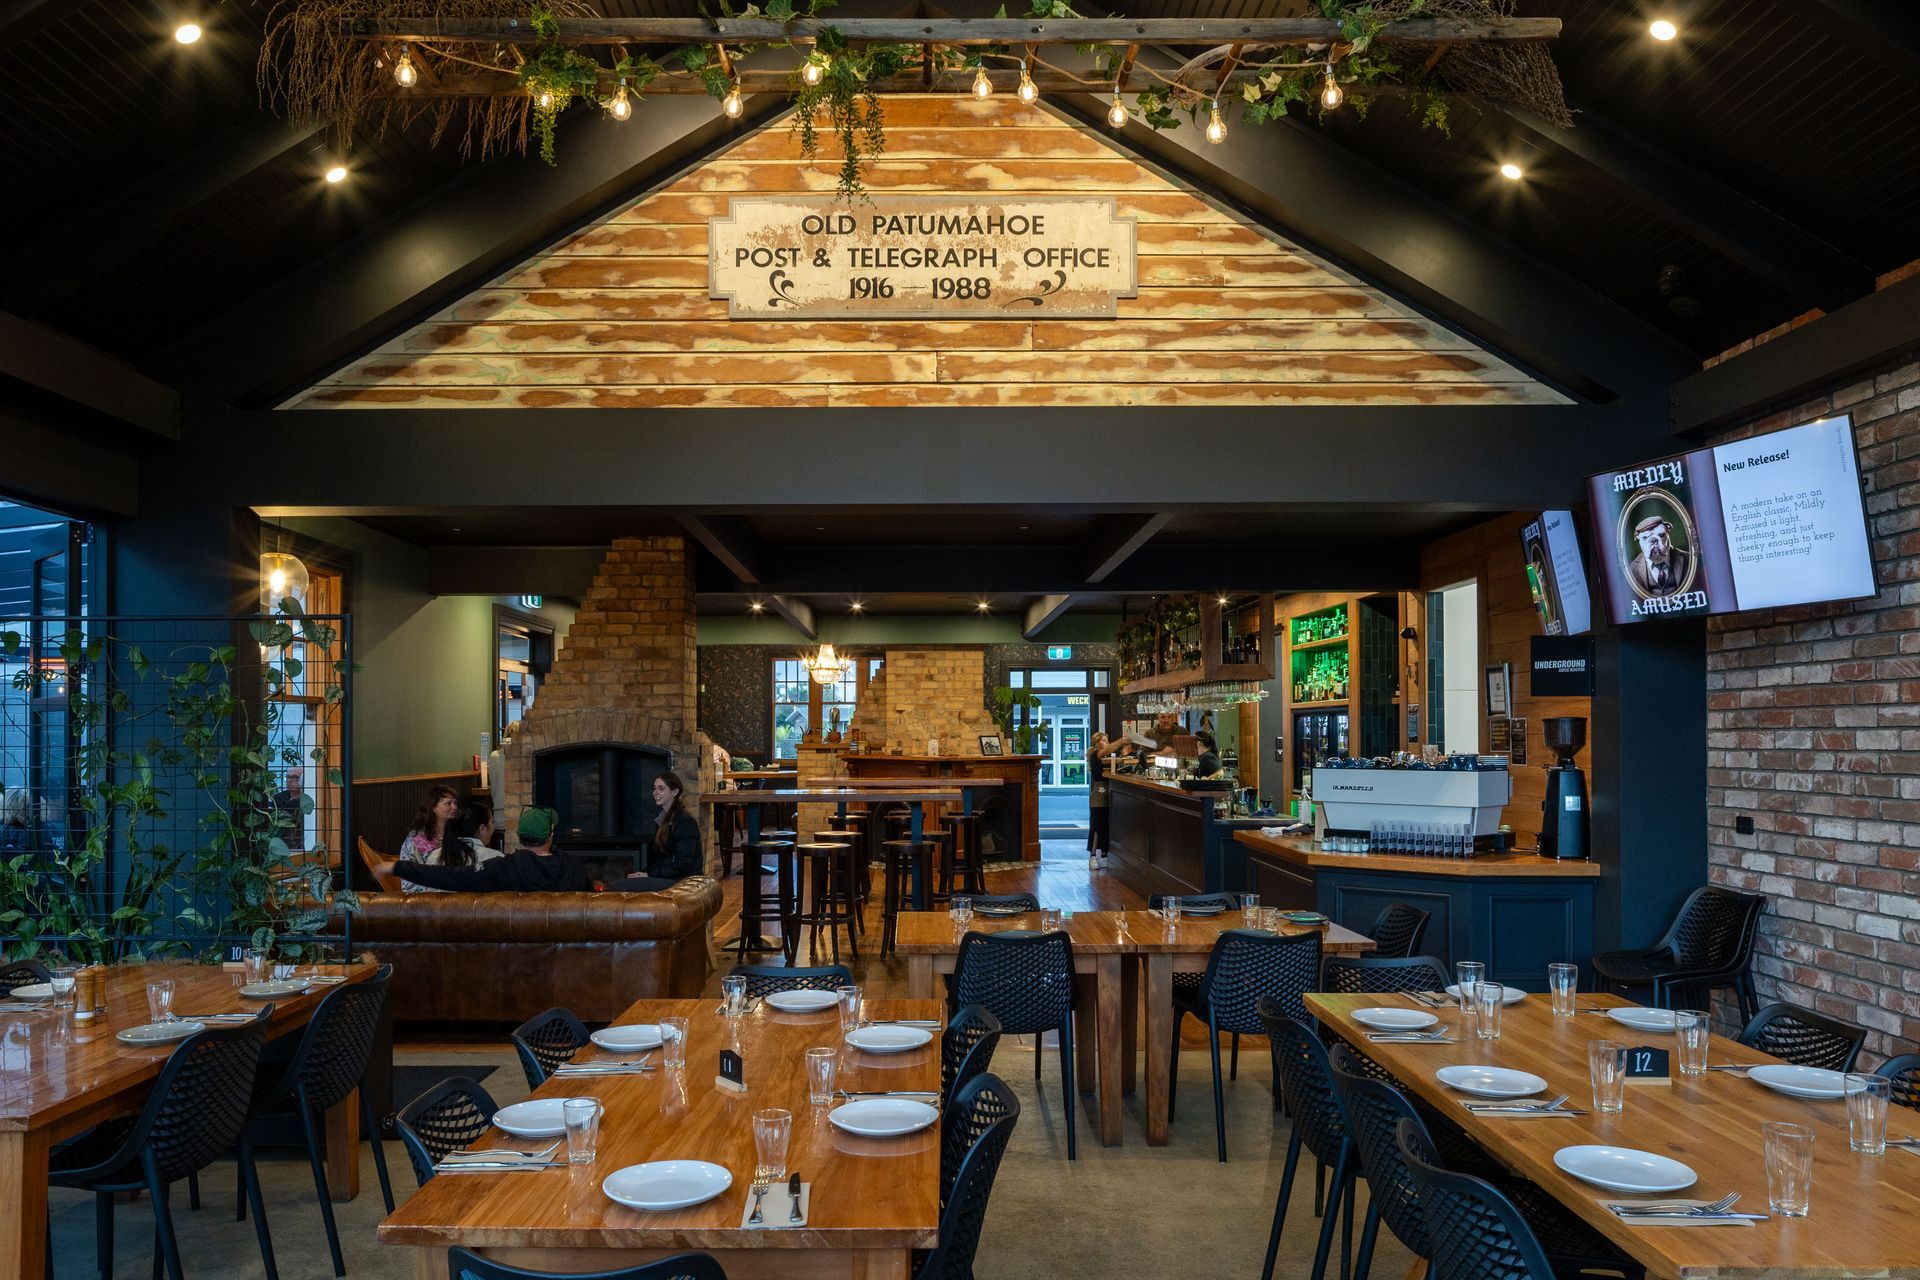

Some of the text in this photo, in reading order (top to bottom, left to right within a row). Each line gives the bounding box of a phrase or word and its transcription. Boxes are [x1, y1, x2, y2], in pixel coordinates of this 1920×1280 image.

[801, 214, 1045, 236] OLD PATUMAHOE
[735, 247, 1110, 268] POST & TELEGRAPH OFFICE
[849, 276, 894, 300] 1916
[931, 276, 991, 300] 1988
[1723, 449, 1790, 473] New Release!
[1614, 460, 1682, 491] MILDLY
[1730, 489, 1823, 512] A modern take on an
[1731, 511, 1762, 524] English
[1794, 498, 1826, 511] Mildly
[1734, 518, 1768, 533] Amused
[1770, 517, 1777, 526] is
[1779, 524, 1797, 535] and
[1799, 522, 1815, 534] just
[1736, 531, 1836, 554] cheeky enough to keep
[1738, 544, 1813, 563] things interesting!
[1631, 590, 1707, 615] AMUSED
[1534, 659, 1586, 670] UNDERGROUND
[231, 946, 242, 960] 10
[723, 1058, 732, 1073] 11
[1635, 1052, 1653, 1073] 12
